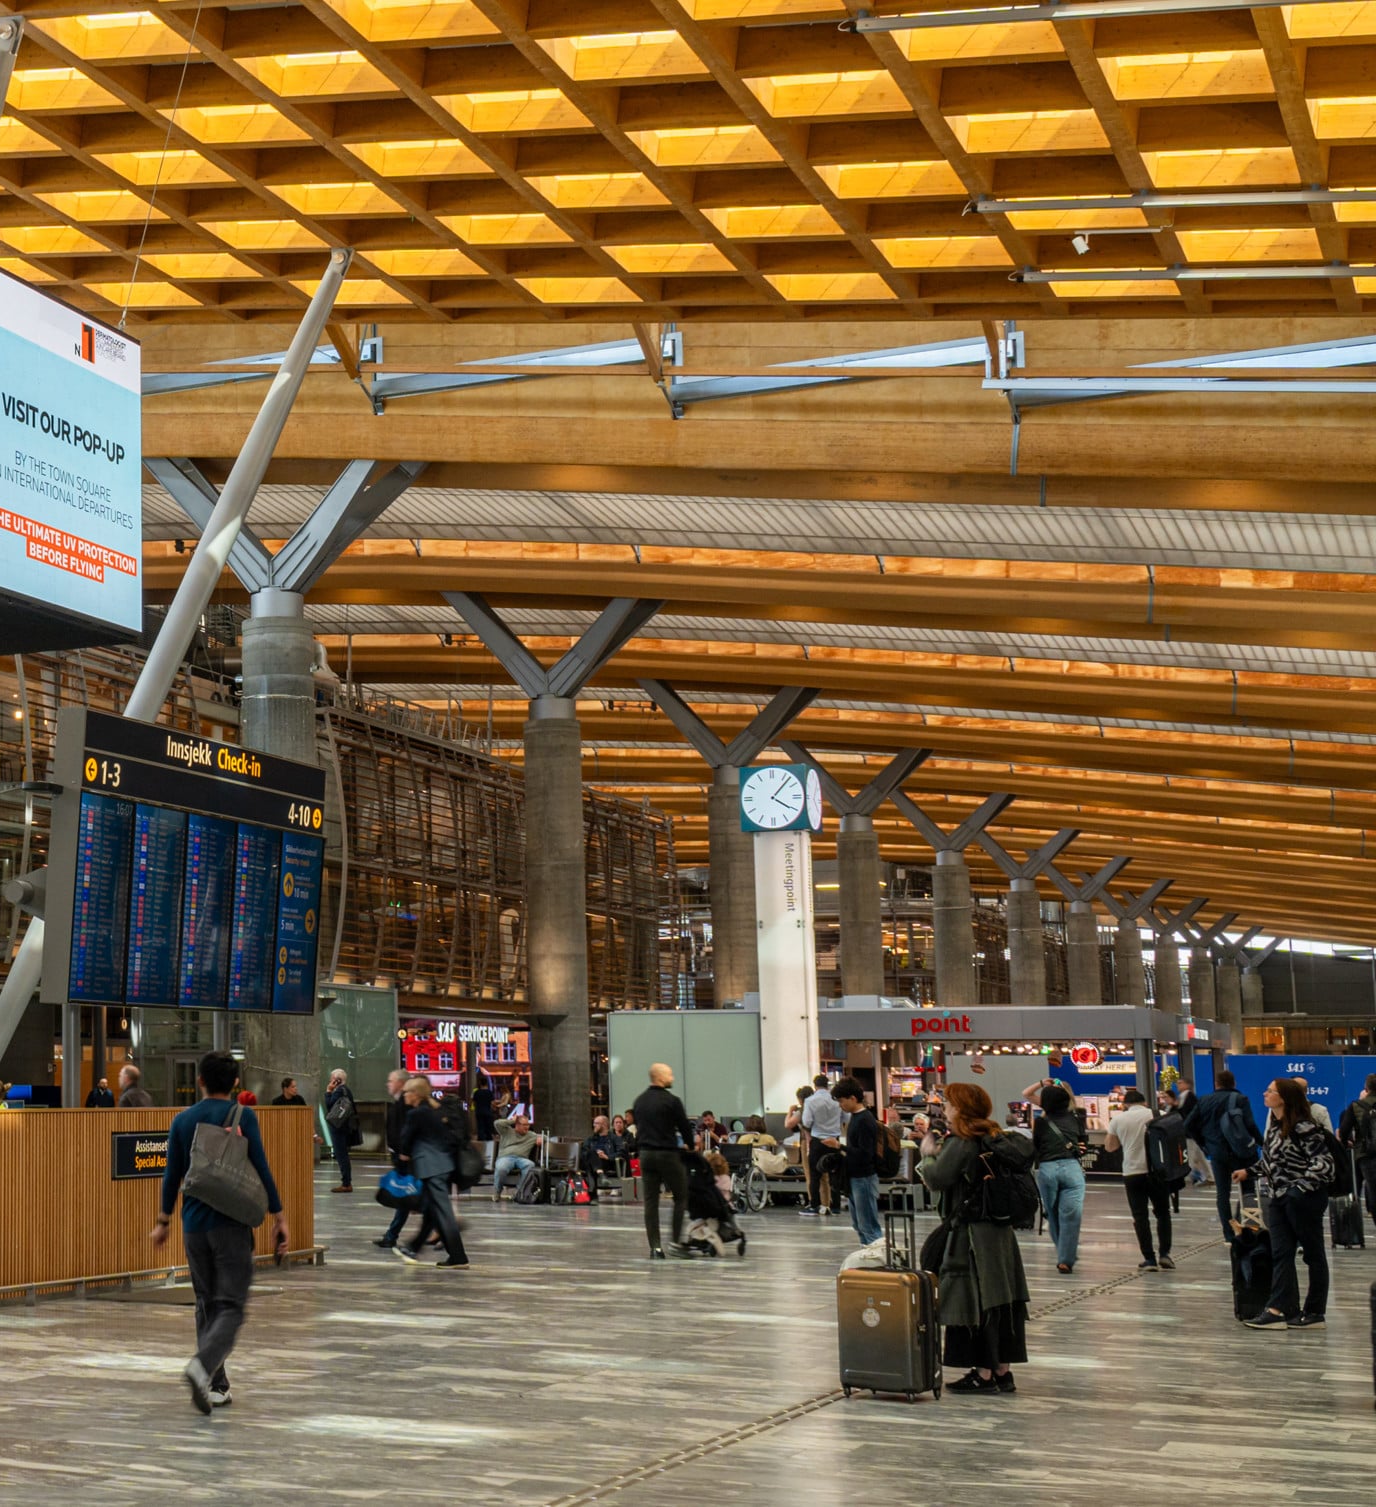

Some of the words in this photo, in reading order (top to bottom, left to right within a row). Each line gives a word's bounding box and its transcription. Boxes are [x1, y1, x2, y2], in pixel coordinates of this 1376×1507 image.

[1, 391, 39, 428] VISIT
[40, 411, 71, 444] OUR
[74, 424, 125, 465] POP-UP
[15, 450, 27, 468] BY
[28, 455, 46, 477] THE
[47, 461, 75, 488] TOWN
[76, 476, 112, 503] SQUARE
[4, 465, 77, 508] INTERNATIONAL
[78, 495, 134, 530] DEPARTURES
[13, 516, 61, 547] ULTIMATE
[62, 535, 77, 551] UV
[78, 539, 136, 574] PROTECTION
[29, 542, 69, 568] BEFORE
[69, 555, 103, 580] FLYING
[166, 735, 212, 768] Innsjekk
[217, 747, 261, 778] Check-in
[101, 760, 121, 788] 1-3
[288, 803, 310, 827] 4-10
[783, 843, 797, 912] Meetingpoint
[435, 1021, 456, 1043] SAS
[458, 1024, 488, 1043] SERVICE
[488, 1025, 509, 1043] POINT
[911, 1010, 972, 1037] point
[1285, 1062, 1306, 1073] SAS
[1310, 1087, 1329, 1095] 5-6-7
[135, 1155, 156, 1172] Special
